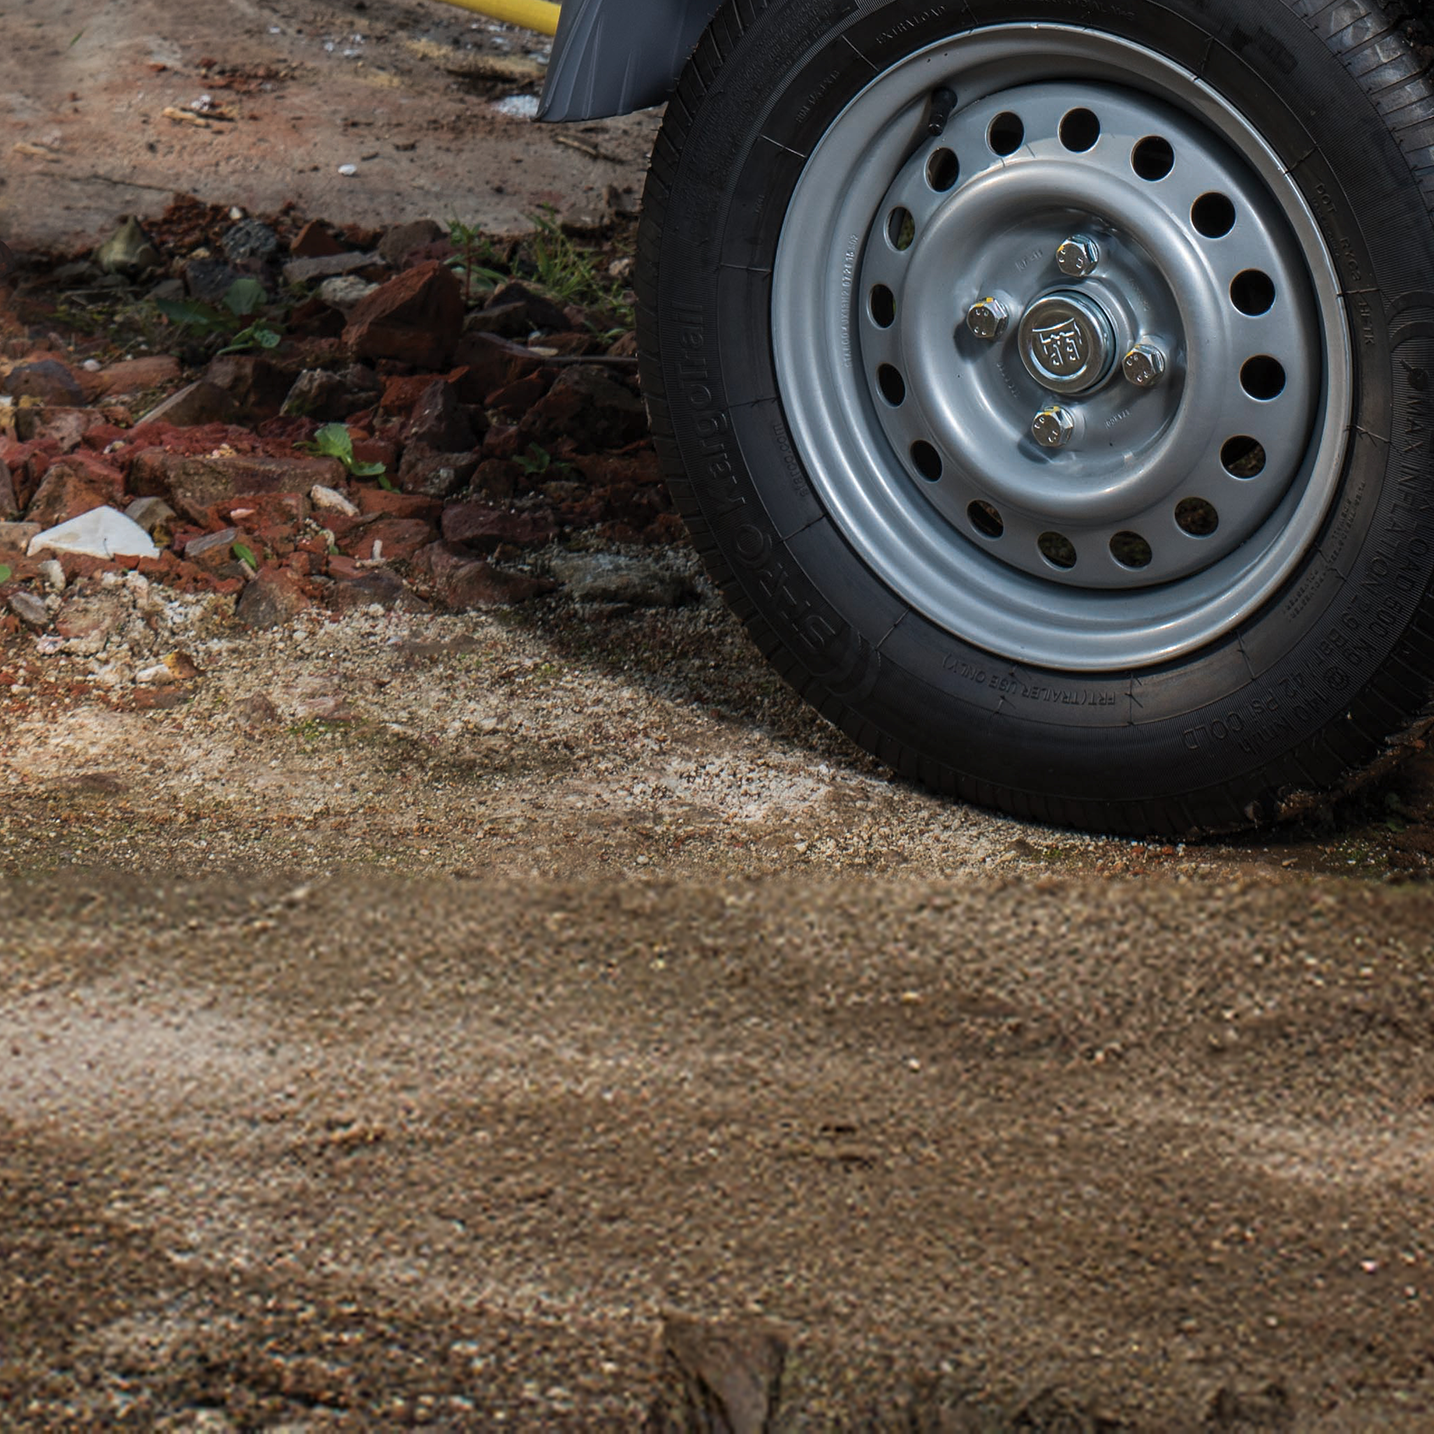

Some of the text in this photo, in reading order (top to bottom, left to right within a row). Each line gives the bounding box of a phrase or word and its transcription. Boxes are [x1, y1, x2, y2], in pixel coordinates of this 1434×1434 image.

[679, 299, 748, 513] KargoTrail
[1402, 396, 1426, 456] MAX
[768, 419, 811, 500] starco.com
[1361, 461, 1420, 593] INFLATION
[987, 671, 1018, 696] USE
[1278, 667, 1307, 699] 42
[1180, 709, 1244, 750] COLD
